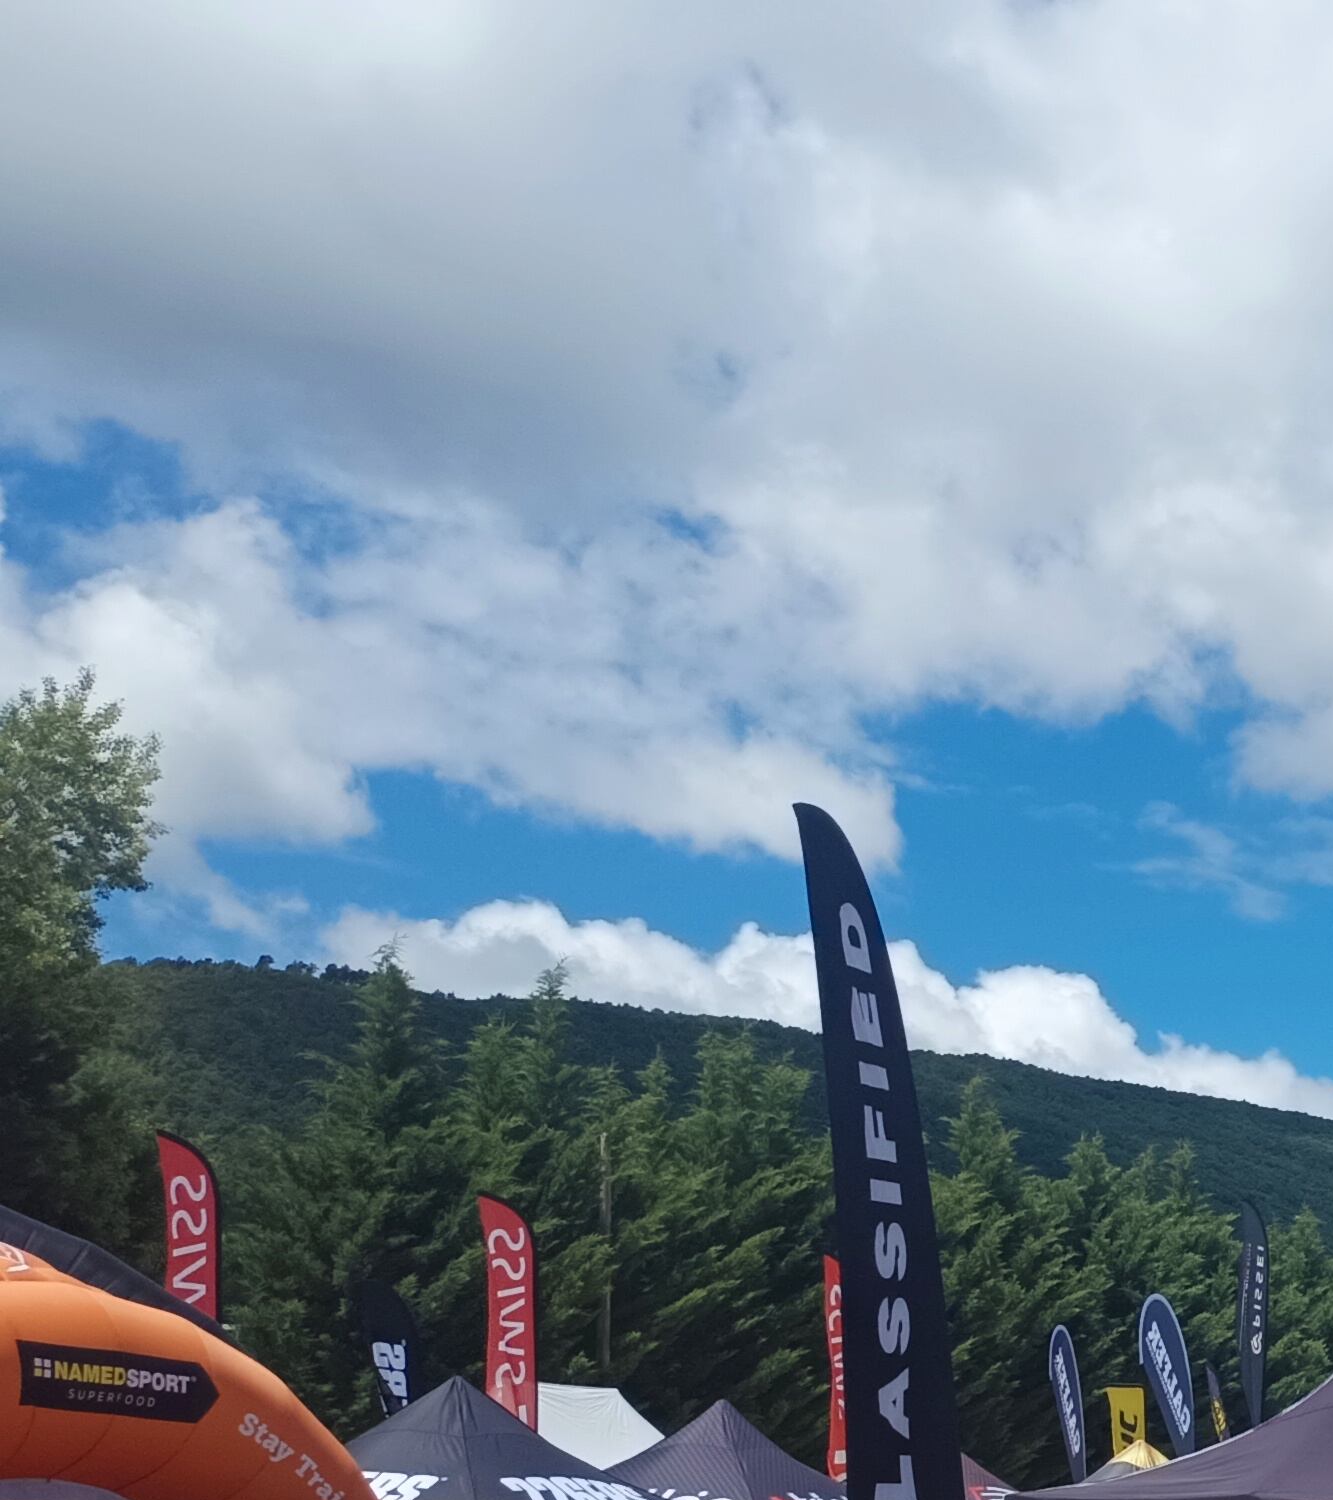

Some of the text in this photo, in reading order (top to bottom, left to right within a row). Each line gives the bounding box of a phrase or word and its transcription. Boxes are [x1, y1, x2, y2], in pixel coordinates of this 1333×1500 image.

[54, 1360, 190, 1395] NAMEDSPORT
[67, 1387, 157, 1408] SUPERFOOD
[238, 1412, 295, 1464] Stay
